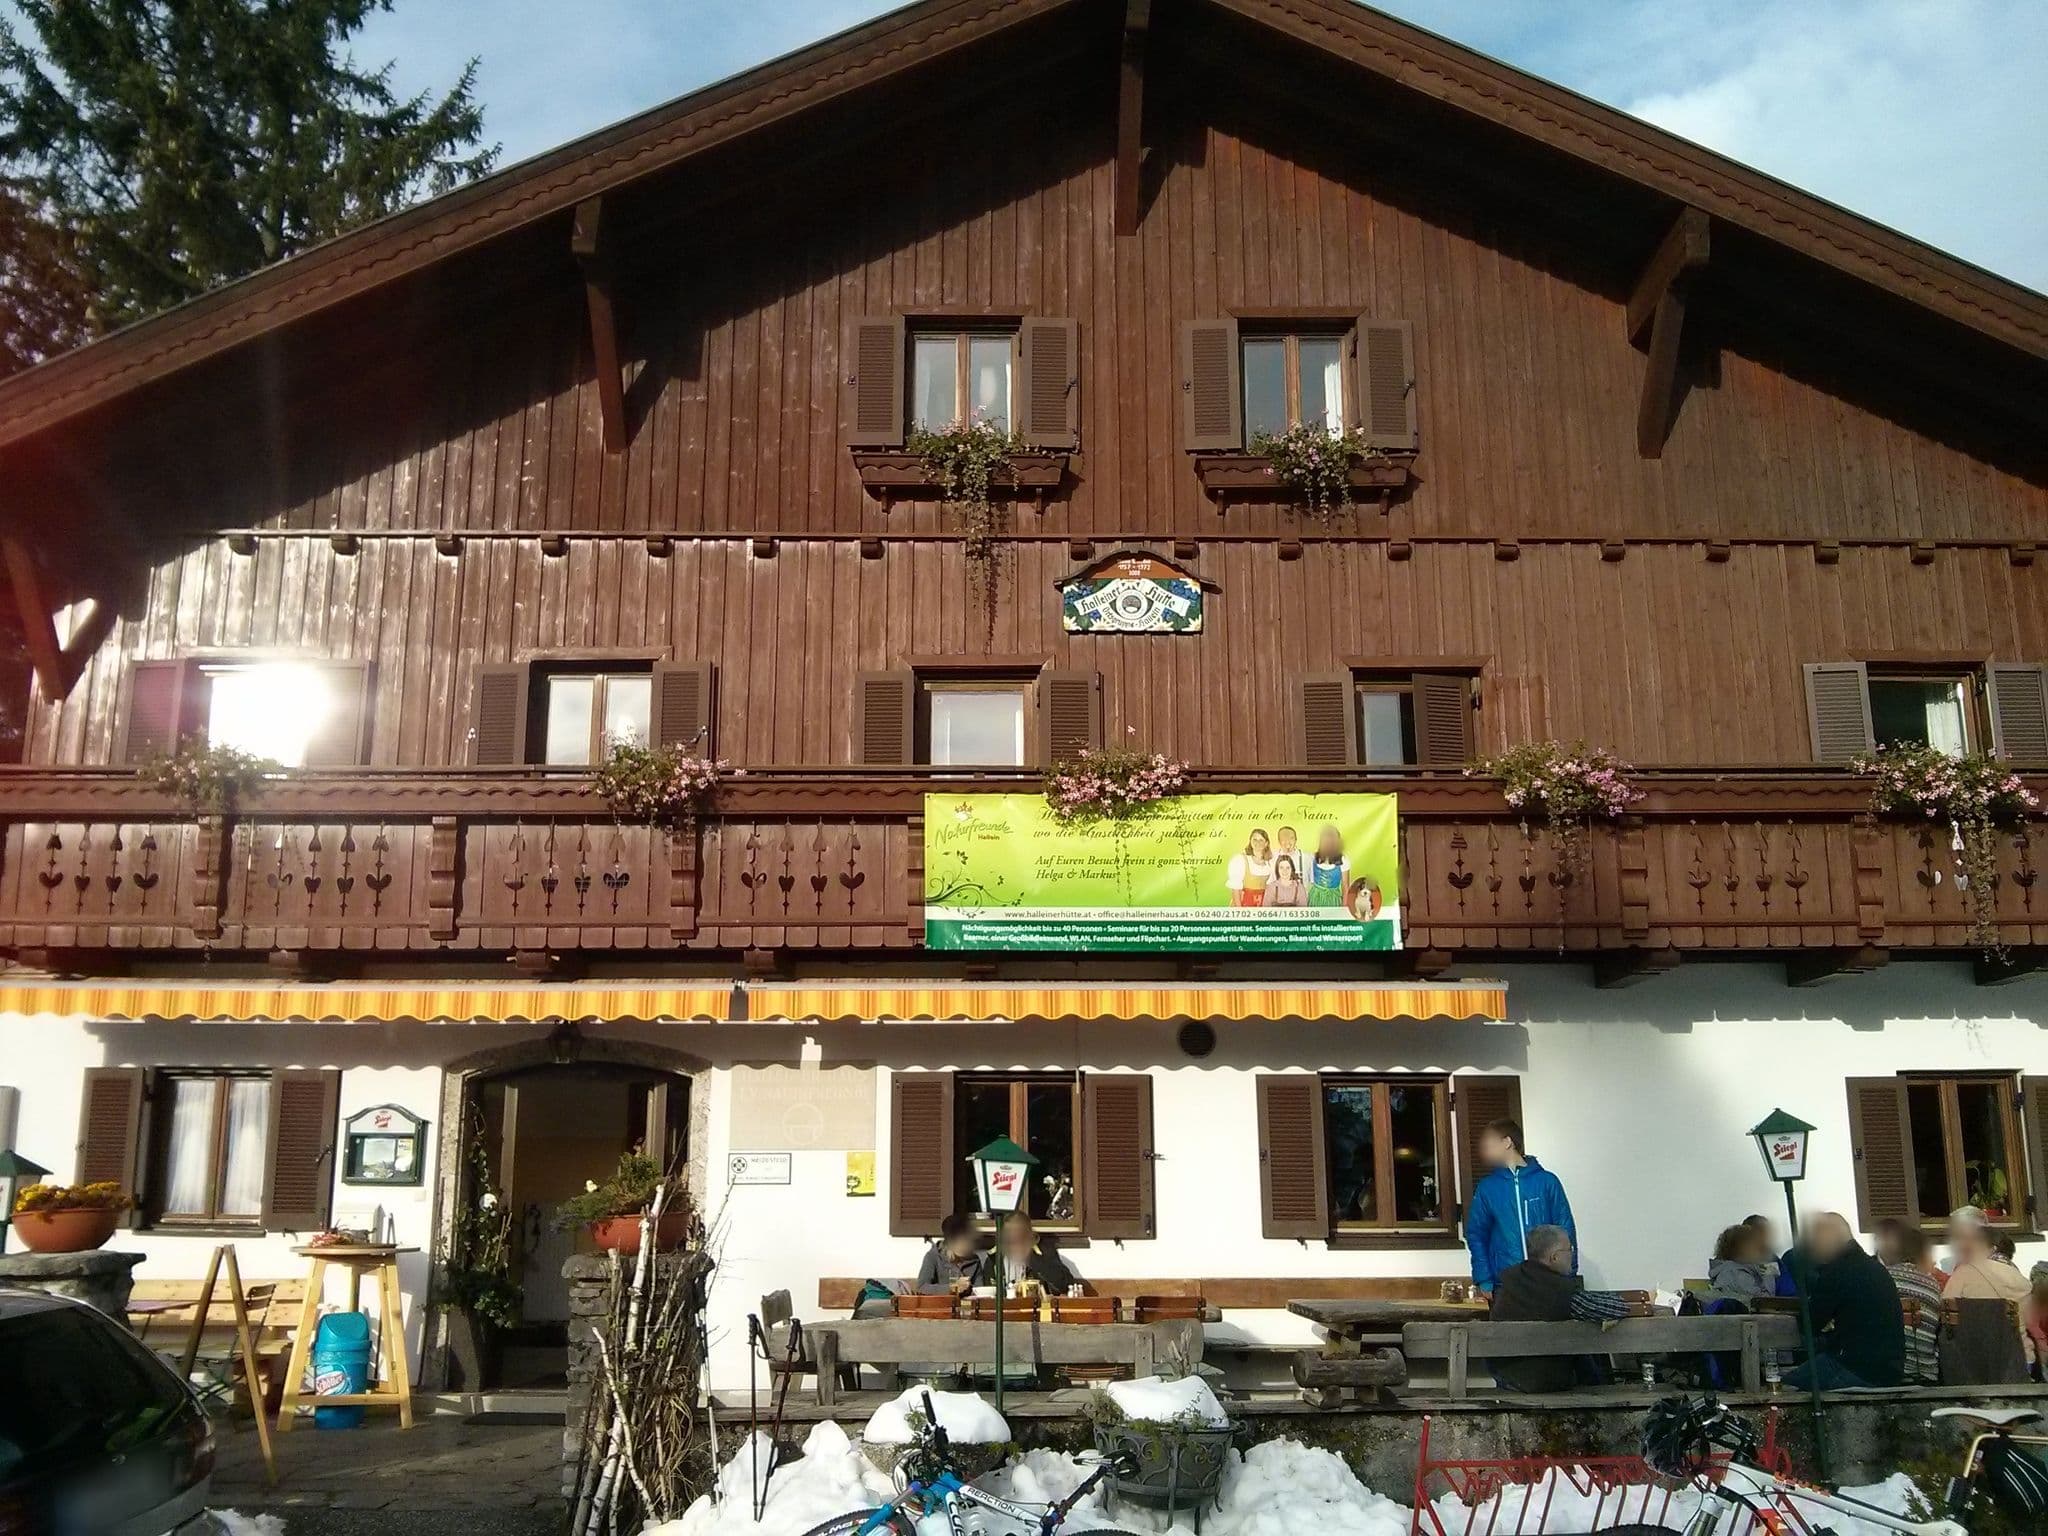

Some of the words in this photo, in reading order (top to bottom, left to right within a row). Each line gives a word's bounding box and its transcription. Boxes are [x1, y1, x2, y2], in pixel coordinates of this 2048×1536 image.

[1080, 587, 1121, 612] Halleiner
[1145, 586, 1176, 609] Hütte
[1217, 807, 1244, 821] drin
[1247, 810, 1261, 821] in
[1264, 807, 1285, 821] der
[935, 818, 1014, 849] Naturfreunde
[1033, 830, 1051, 839] wo
[1055, 826, 1074, 839] die
[1035, 854, 1057, 867] Auf
[1056, 855, 1085, 866] Euren
[1087, 855, 1120, 866] Besuch
[1148, 855, 1156, 866] si
[1035, 868, 1064, 880] Helga
[1066, 868, 1078, 879] &
[1078, 868, 1117, 879] Markus
[1004, 910, 1092, 919] www.halleinerhütte.at
[1097, 910, 1189, 919] office@halleinerhaus.at
[1071, 924, 1103, 933] Personen
[1107, 924, 1139, 933] Seminare
[1150, 924, 1161, 932] bis
[1179, 924, 1211, 933] Personen
[1299, 924, 1312, 932] mit
[1126, 934, 1140, 943] und
[1176, 934, 1229, 944] Ausgangspunkt
[1308, 934, 1322, 942] und
[1322, 934, 1364, 943] Wintersport
[1773, 1141, 1798, 1158] Stiegl
[992, 1171, 1018, 1186] Stiegl
[966, 1487, 1017, 1513] REACTION
